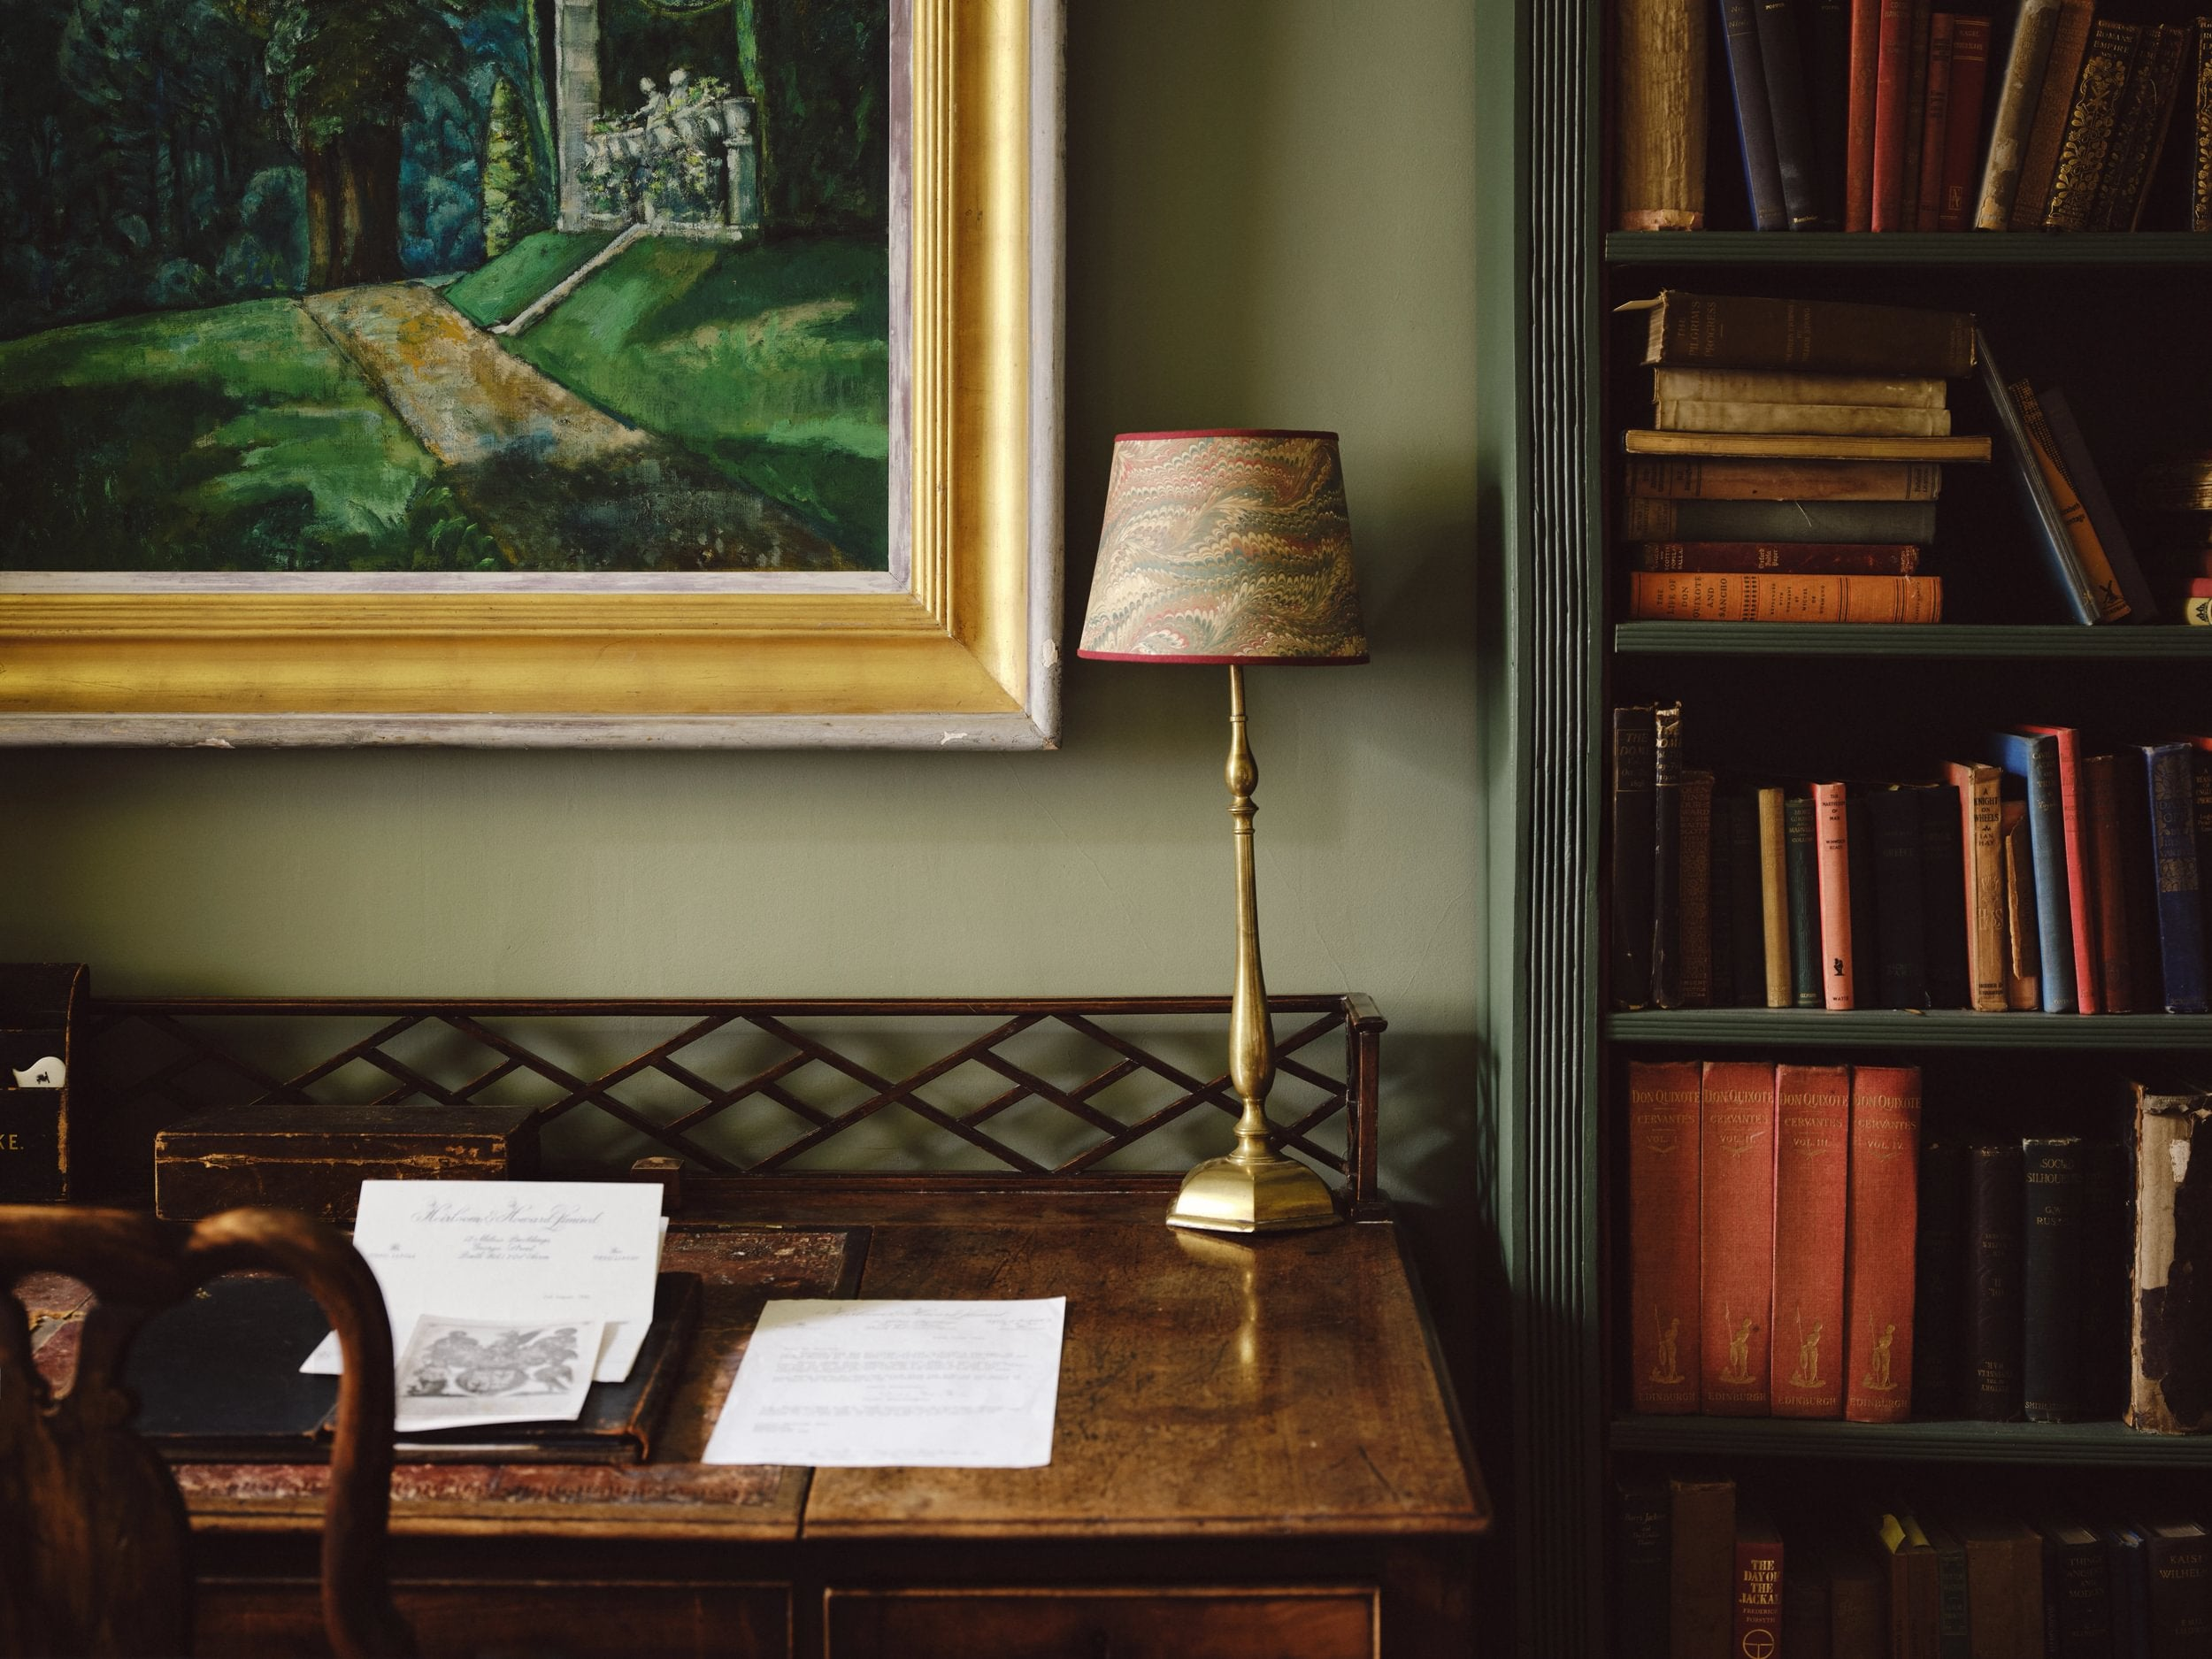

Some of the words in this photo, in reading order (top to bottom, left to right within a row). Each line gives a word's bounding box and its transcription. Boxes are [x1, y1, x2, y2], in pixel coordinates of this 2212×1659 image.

[1704, 301, 1716, 357] PROGRESS
[1668, 578, 1676, 591] OF
[1693, 576, 1701, 618] QUIXOTE
[1718, 578, 1727, 618] SANCHO
[1632, 1089, 1653, 1103] DON
[1655, 1089, 1701, 1105] QUIXOTE
[1704, 1089, 1728, 1103] DON
[1729, 1089, 1774, 1105] QUIXOTE
[1779, 1093, 1801, 1106] DON
[1803, 1092, 1848, 1108] QUIXOTE
[1855, 1094, 1877, 1108] DON
[1878, 1094, 1922, 1110] QUIXOTE
[1637, 1114, 1695, 1125] CERVANTES
[1710, 1114, 1769, 1125] CERVANTES
[1784, 1118, 1842, 1127] CERVANTES
[1857, 1118, 1917, 1130] CERVANTES
[1639, 1391, 1696, 1402] EDINBURGH
[1708, 1391, 1767, 1402] EDINBURGH
[1778, 1395, 1837, 1406] EDINBURGH
[1849, 1397, 1909, 1408] EDINBURGH
[1750, 1559, 1775, 1571] THE
[1743, 1571, 1766, 1582] DAY
[1750, 1582, 1774, 1594] THE
